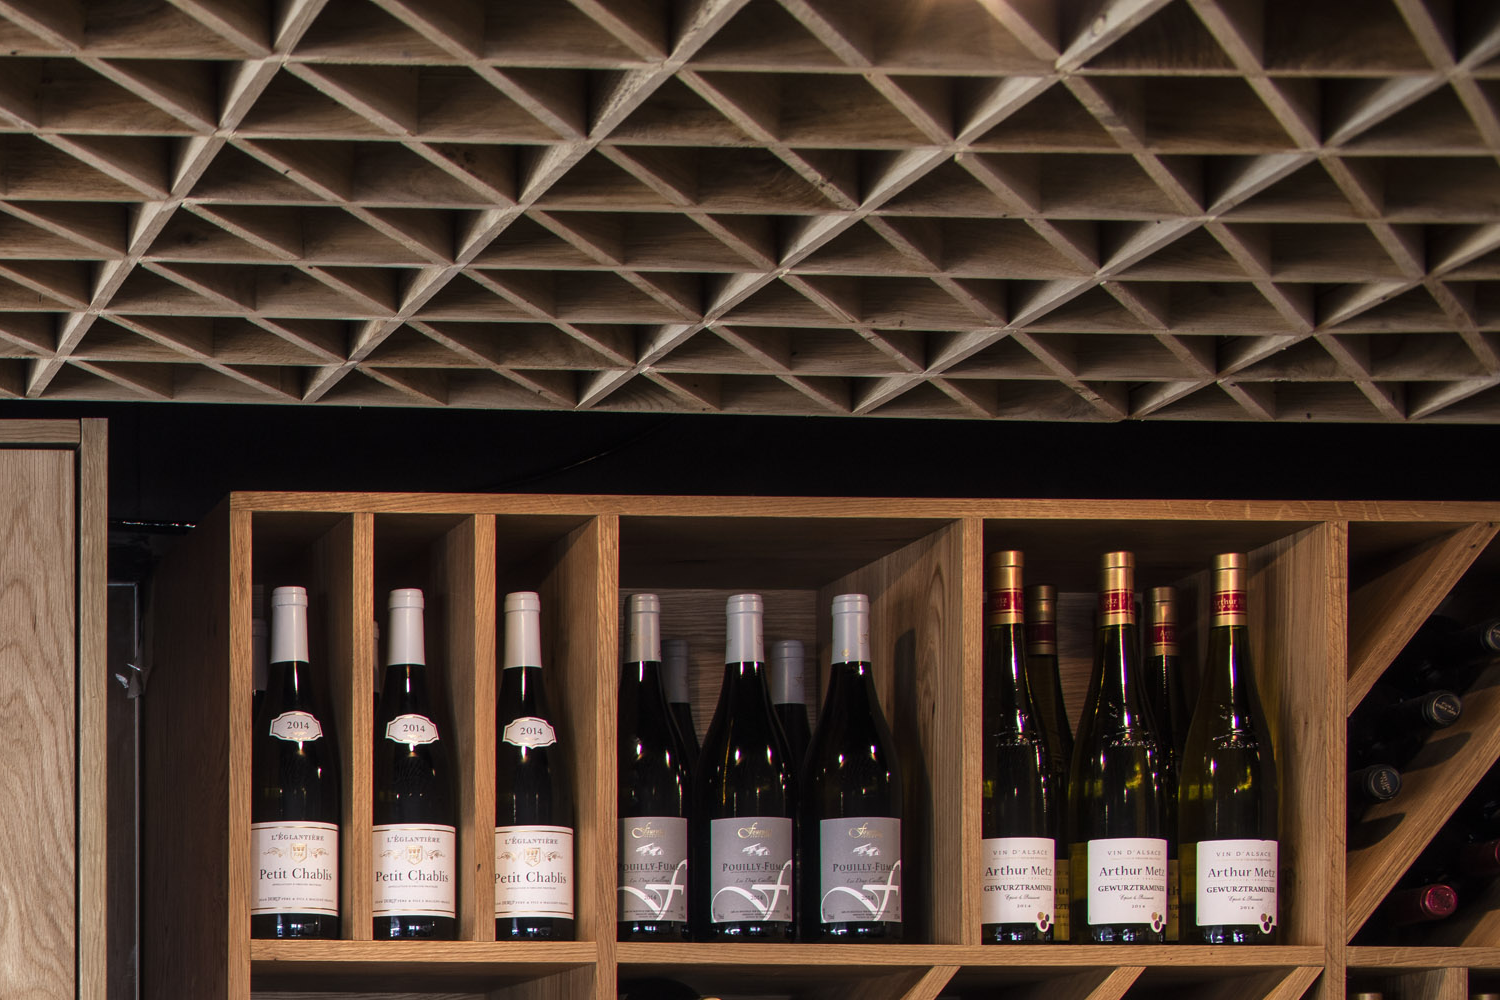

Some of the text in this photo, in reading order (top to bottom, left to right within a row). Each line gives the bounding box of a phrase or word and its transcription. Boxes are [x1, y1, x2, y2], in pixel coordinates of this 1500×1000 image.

[287, 721, 310, 730] 2014
[403, 724, 426, 733] 2014
[520, 726, 543, 735] 2014
[271, 832, 324, 841] L'ÉGLANTIÈRE
[260, 867, 332, 881] Petit Chablis
[376, 869, 449, 882] Petit Chablis
[985, 865, 1052, 876] Arthur Metz
[1099, 865, 1165, 877] Arthur Metz
[1208, 867, 1275, 878] Arthur Metz
[495, 871, 567, 884] Petit Chablis
[983, 884, 1052, 892] GEWURZTRAMINER
[1098, 884, 1165, 892] GEWURZTRAMINER
